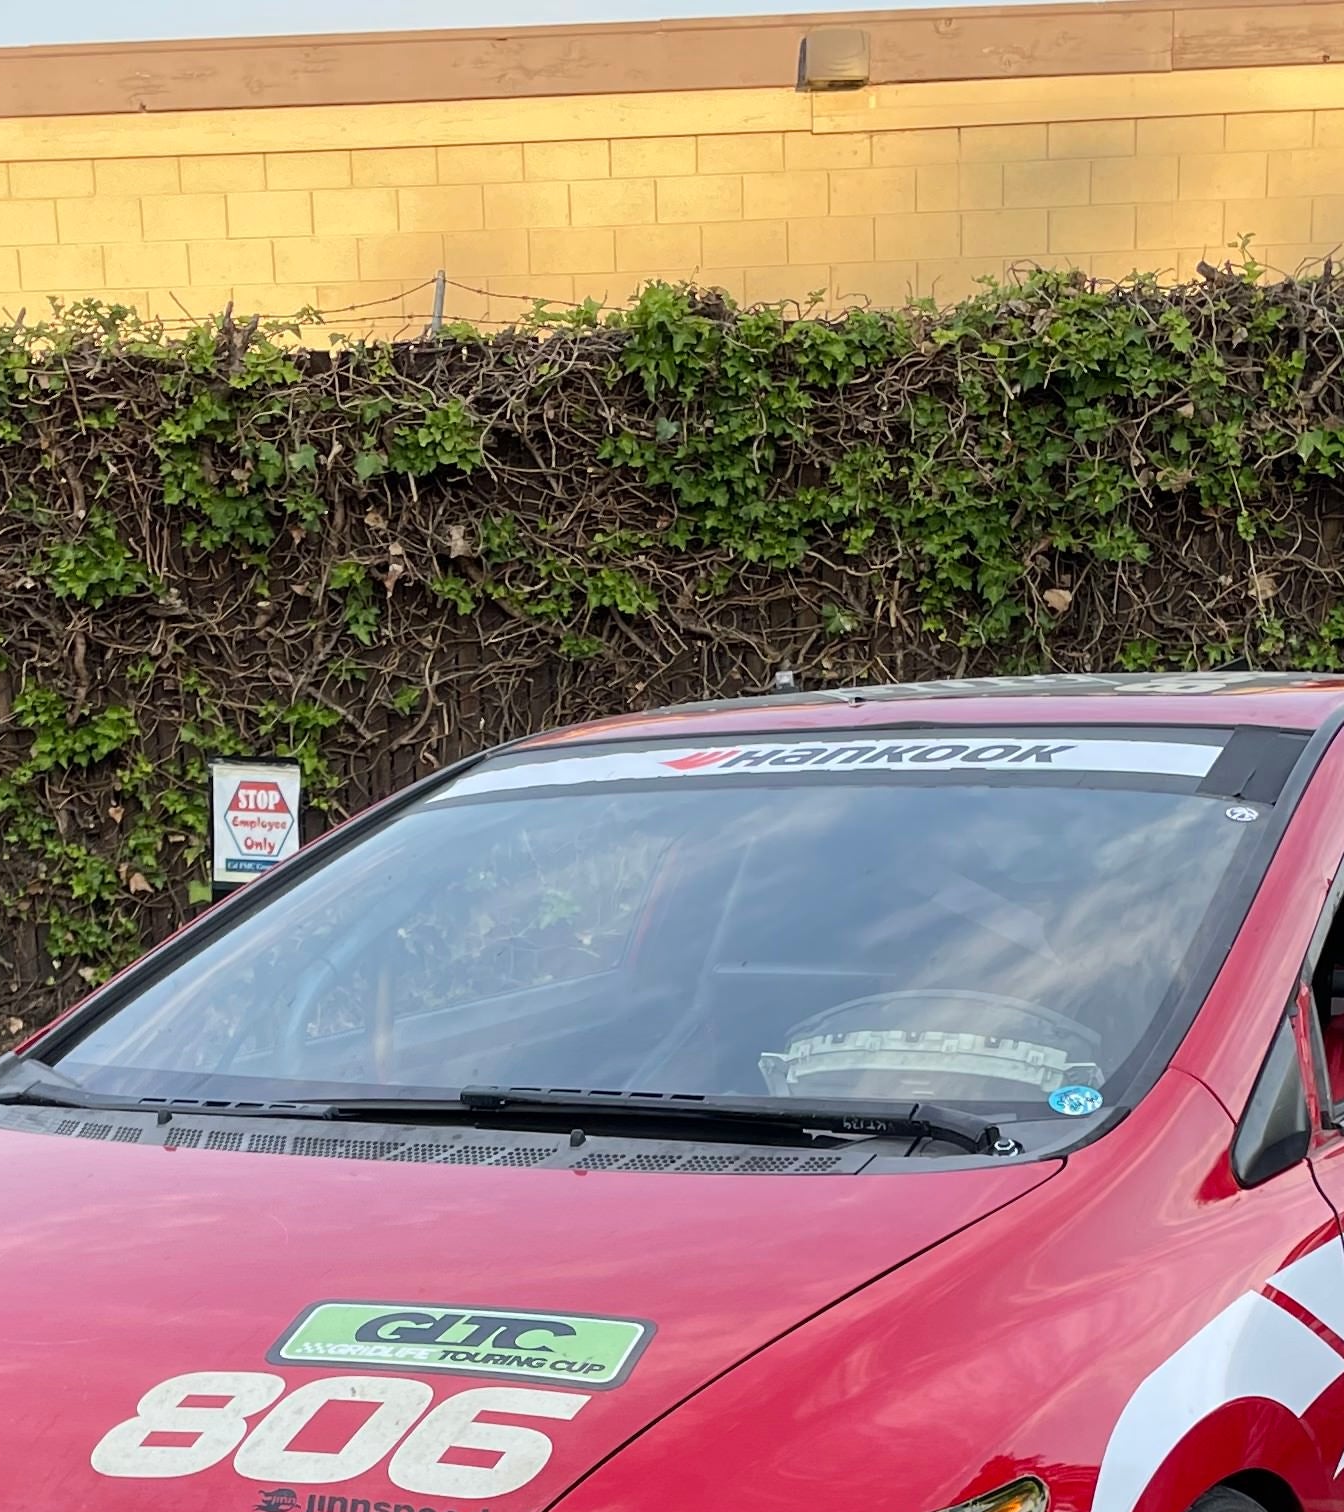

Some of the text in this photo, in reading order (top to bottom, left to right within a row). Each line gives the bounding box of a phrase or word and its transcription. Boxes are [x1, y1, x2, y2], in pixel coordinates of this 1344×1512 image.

[238, 789, 281, 810] STOP
[232, 816, 288, 832] Employee
[244, 837, 276, 855] Only
[324, 1343, 606, 1375] GRIDLIFE TOURING CUP
[91, 1371, 591, 1499] 806
